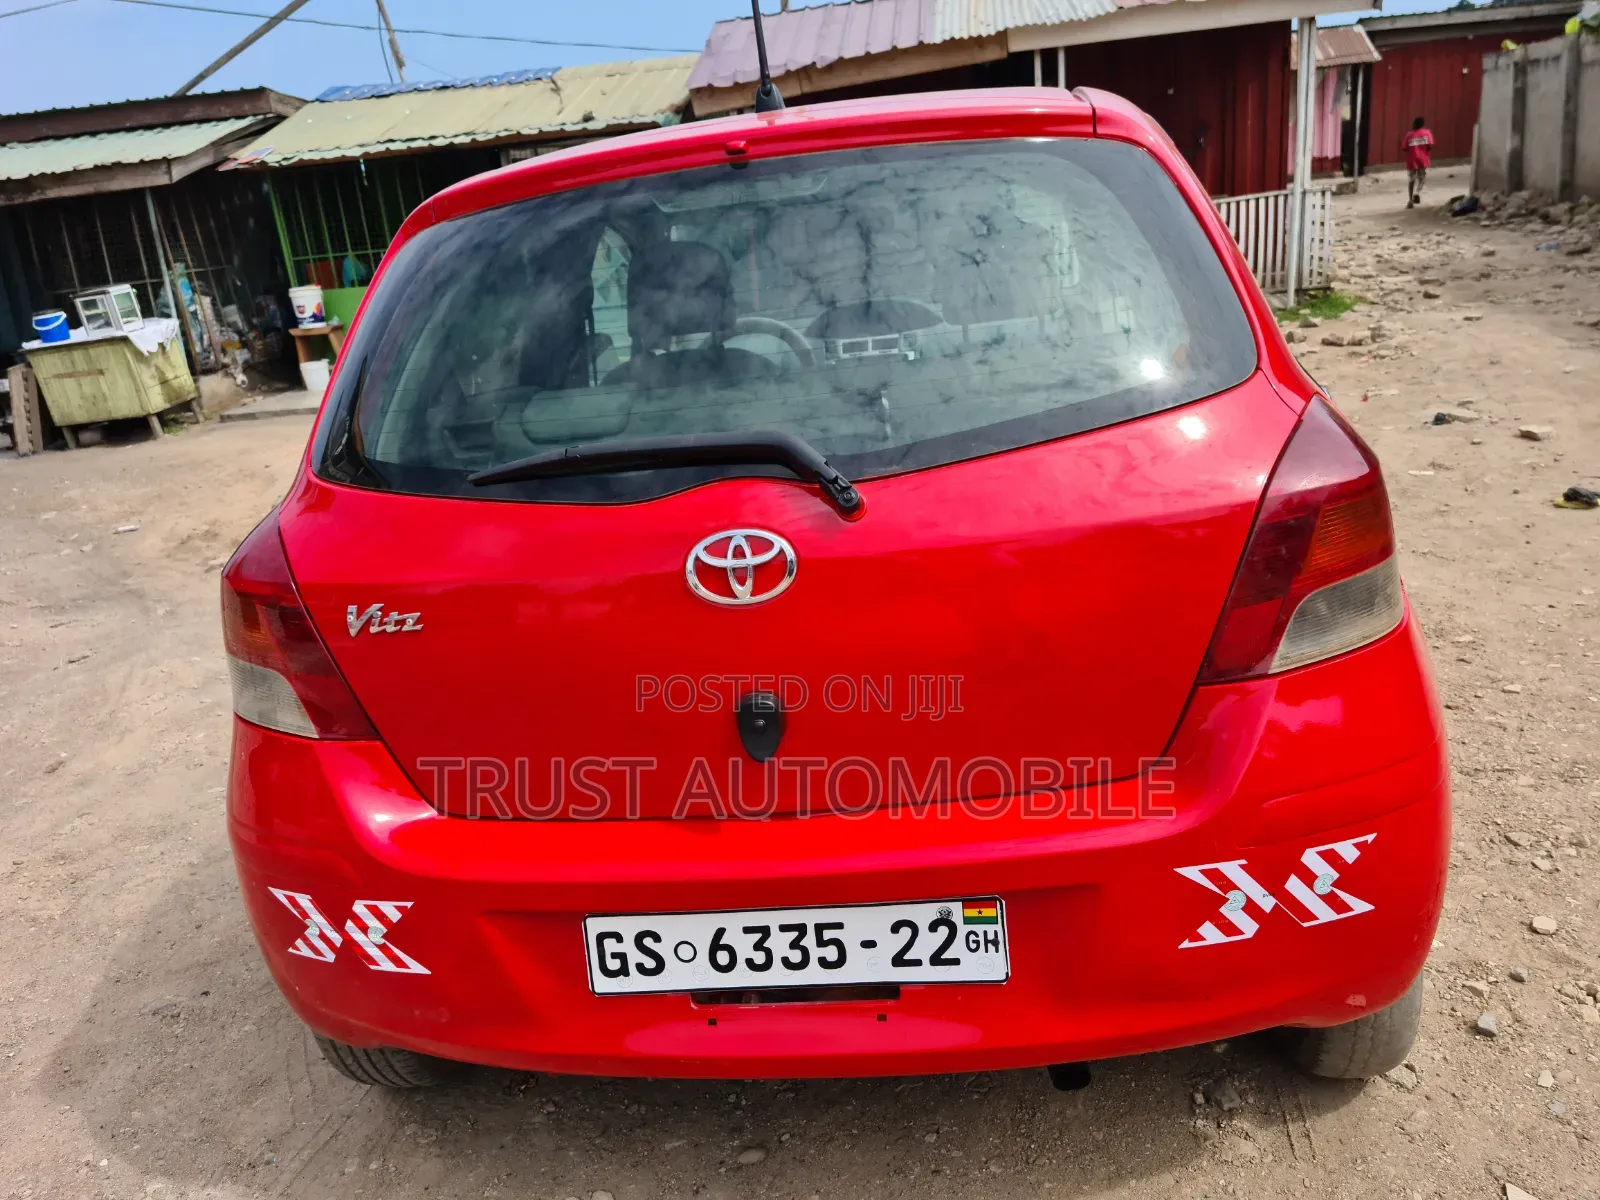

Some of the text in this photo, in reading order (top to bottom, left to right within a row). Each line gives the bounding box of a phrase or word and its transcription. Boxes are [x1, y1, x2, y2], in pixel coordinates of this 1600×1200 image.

[346, 603, 424, 638] Vitz
[596, 929, 666, 978] GS
[964, 929, 1000, 954] GH
